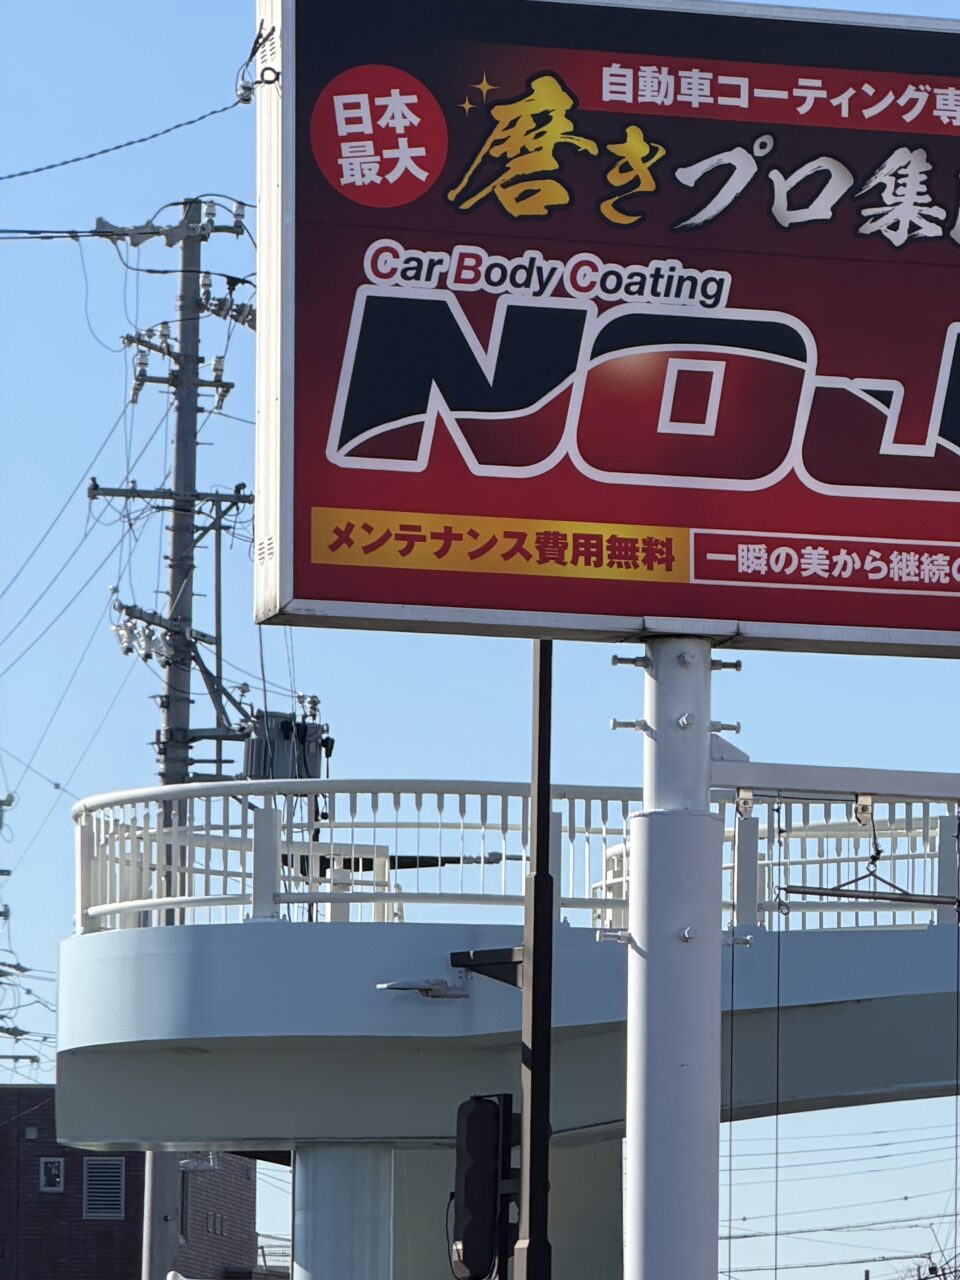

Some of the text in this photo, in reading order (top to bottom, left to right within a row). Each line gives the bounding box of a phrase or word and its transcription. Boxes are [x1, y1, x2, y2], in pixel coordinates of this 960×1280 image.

[333, 89, 422, 136] 日本
[337, 138, 429, 187] 最大
[368, 243, 725, 309] Car Body Coating
[329, 519, 676, 572] メンテナンス費用無料
